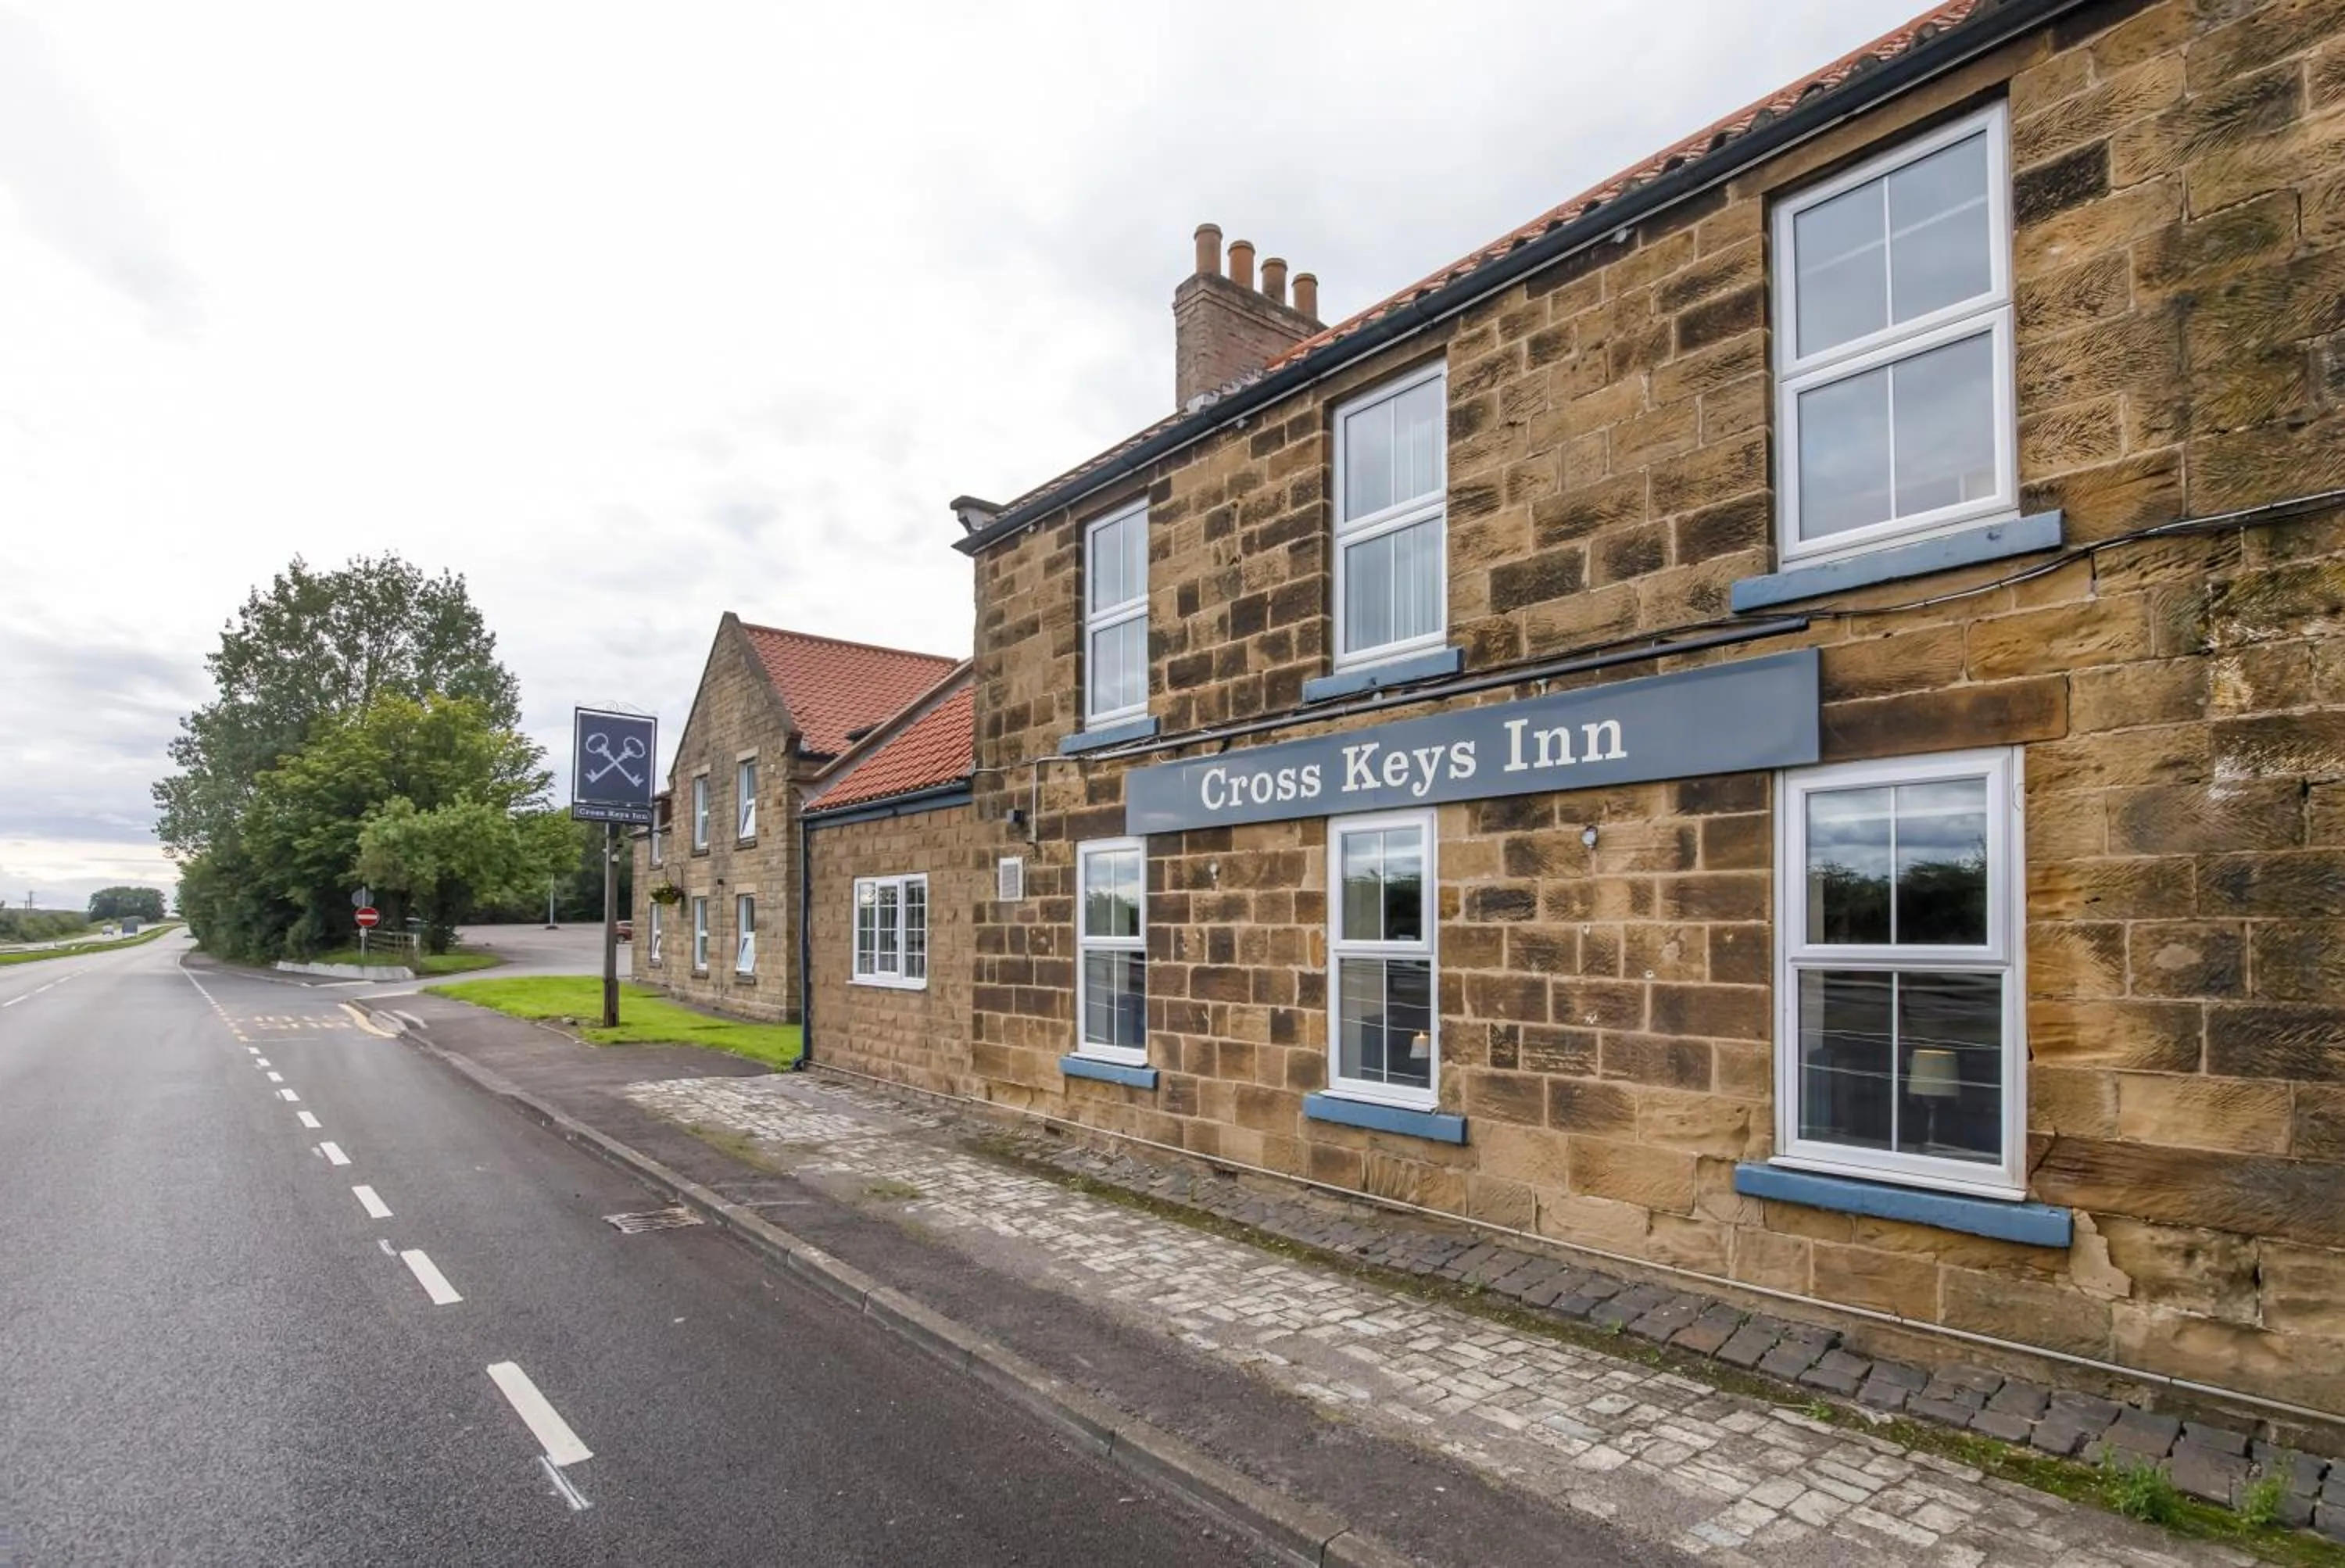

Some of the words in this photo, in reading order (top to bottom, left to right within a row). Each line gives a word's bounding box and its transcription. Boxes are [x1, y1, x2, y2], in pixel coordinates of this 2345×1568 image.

[1201, 763, 1322, 811] Cross
[1341, 739, 1477, 797] Keys
[1502, 718, 1628, 772] Inn
